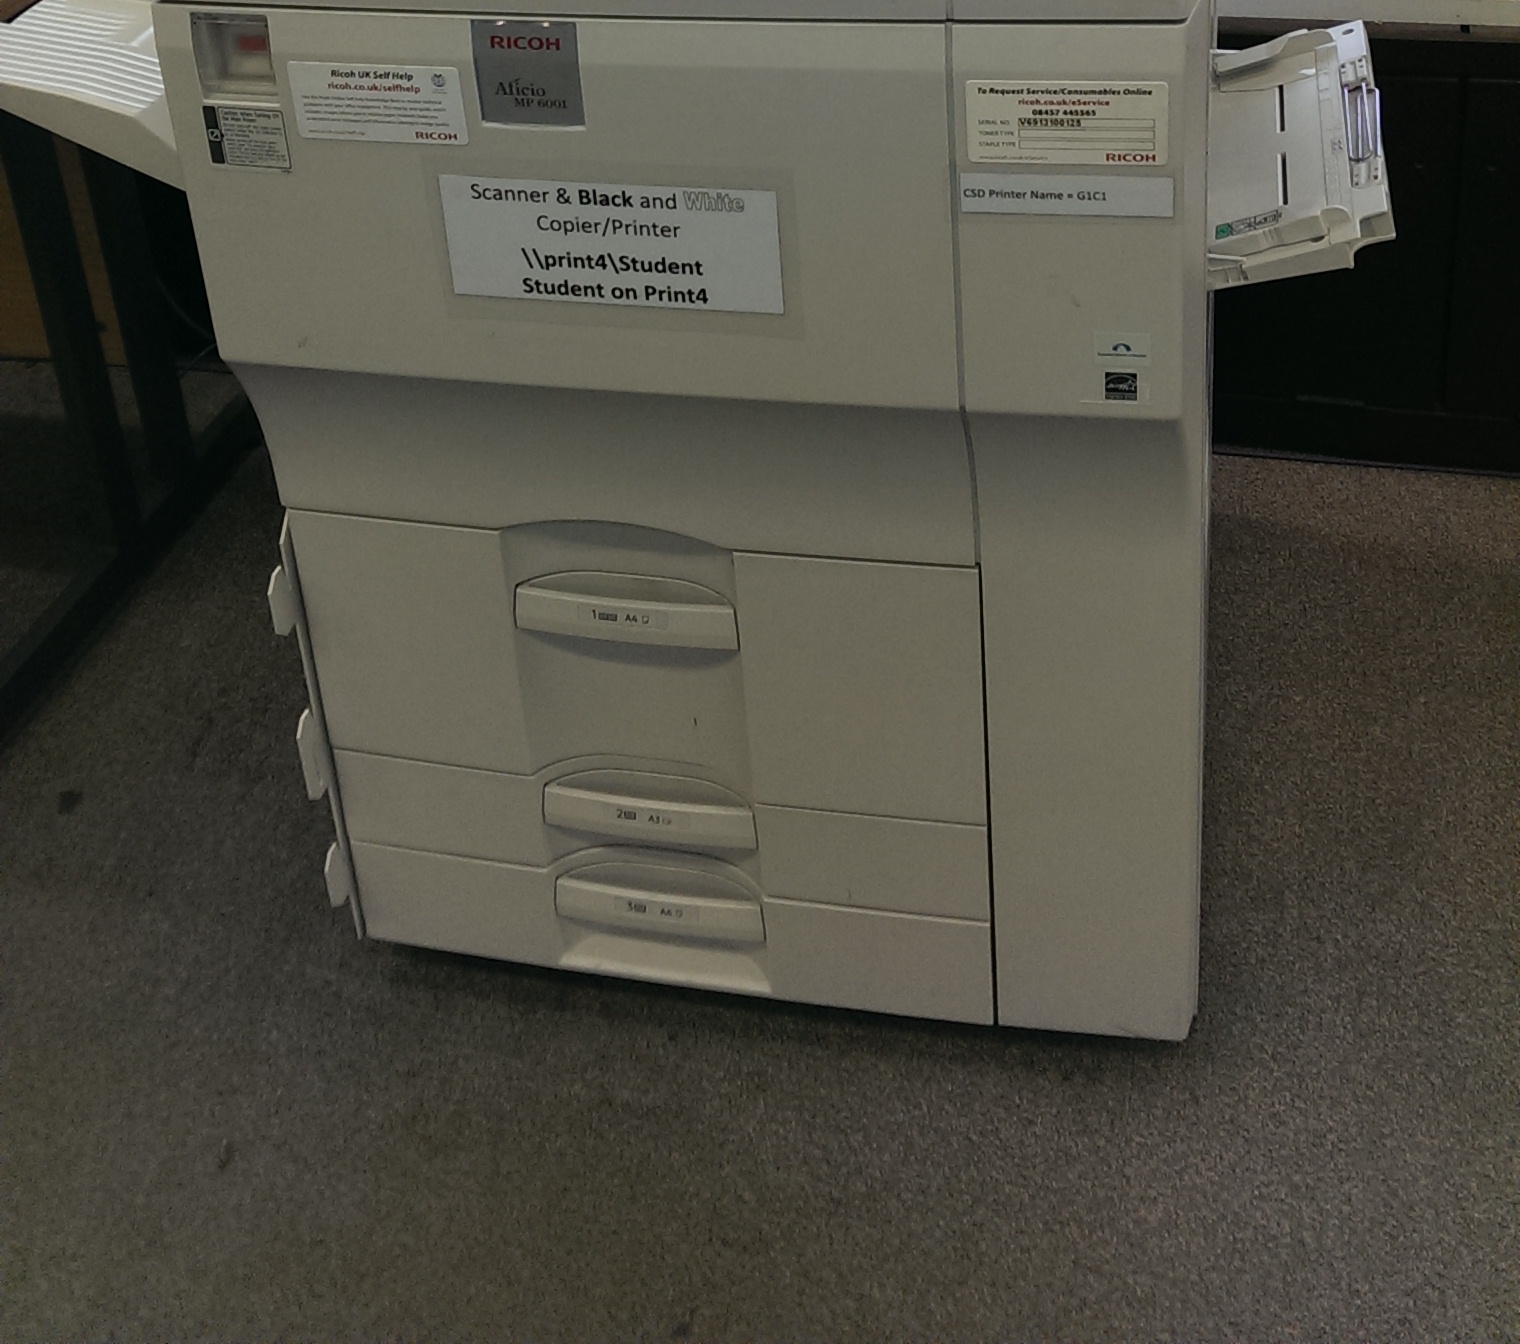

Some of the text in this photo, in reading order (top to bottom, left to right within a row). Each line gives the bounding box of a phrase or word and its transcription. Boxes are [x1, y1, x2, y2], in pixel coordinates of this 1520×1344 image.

[490, 35, 560, 51] RICOH
[331, 69, 414, 82] Ricoh UK Self Help
[328, 82, 421, 95] ricoh.co.uk/selfhelp
[495, 77, 546, 96] Aficio
[989, 87, 1024, 96] Request
[1026, 88, 1121, 96] Service/Consumables
[1122, 88, 1153, 96] Online
[514, 97, 567, 109] MP 6001
[1018, 98, 1110, 106] ricoh.co.uk/eService
[415, 131, 458, 142] RICOH
[1105, 153, 1156, 162] RICOH
[470, 183, 745, 213] Scanner & Black and White
[963, 188, 986, 198] CSD
[988, 189, 1027, 200] Printer
[1030, 190, 1064, 200] Name
[1076, 190, 1107, 201] G1C1
[536, 215, 681, 238] Copier/Printer
[521, 247, 704, 276] \\print4\Student
[522, 277, 709, 305] Student on Print4
[625, 614, 638, 623] A4
[648, 815, 660, 825] A3
